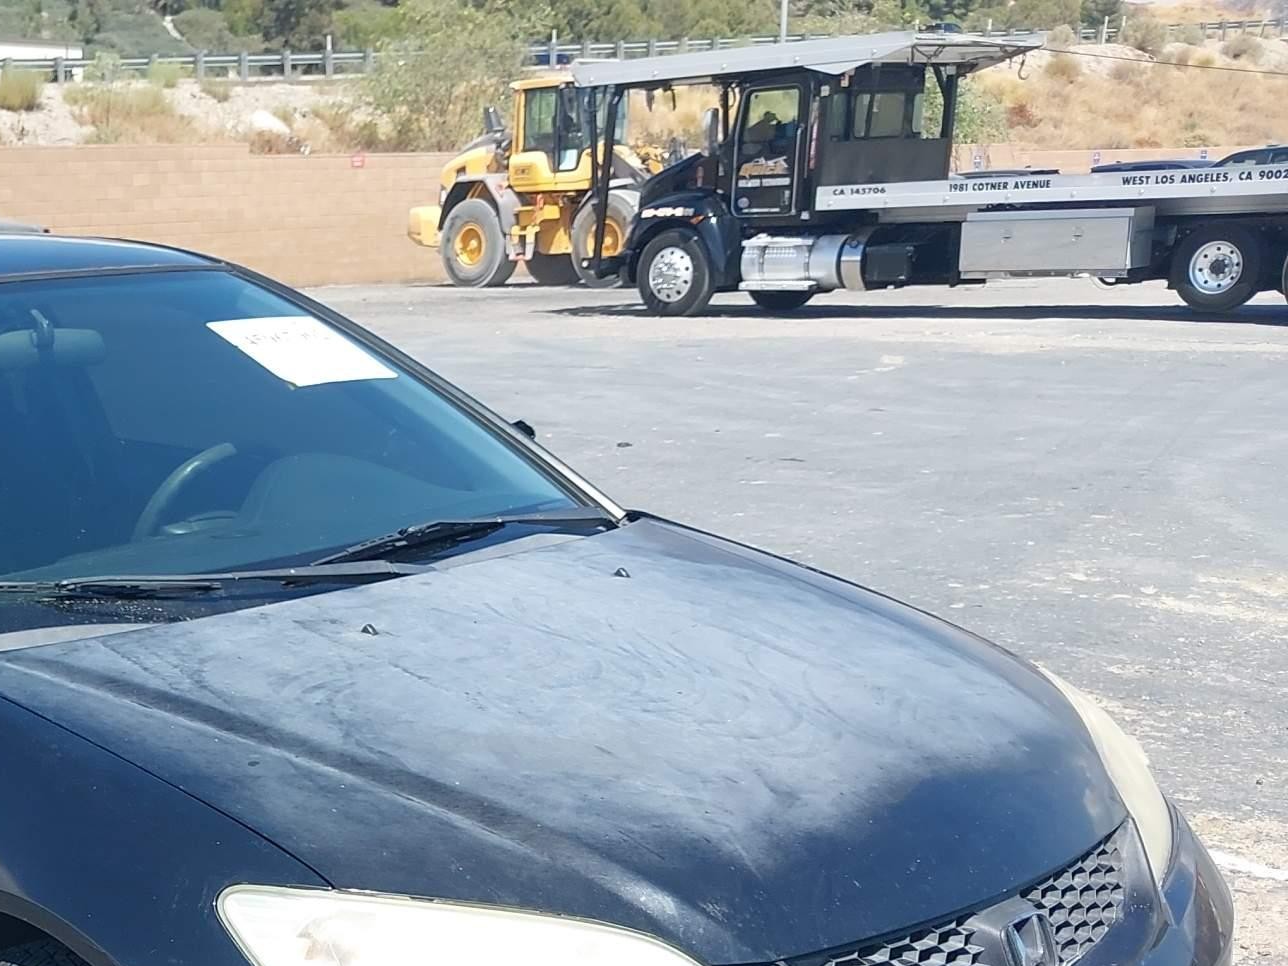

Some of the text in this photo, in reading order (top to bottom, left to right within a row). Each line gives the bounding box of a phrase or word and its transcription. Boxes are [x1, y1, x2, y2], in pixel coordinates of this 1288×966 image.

[1122, 175, 1151, 185] WEST
[1155, 174, 1175, 184] LOS
[1180, 172, 1233, 184] ANGELES,
[1238, 171, 1253, 181] CA
[832, 188, 845, 196] CA
[949, 179, 1052, 192] 1981 COTNER AVENUE
